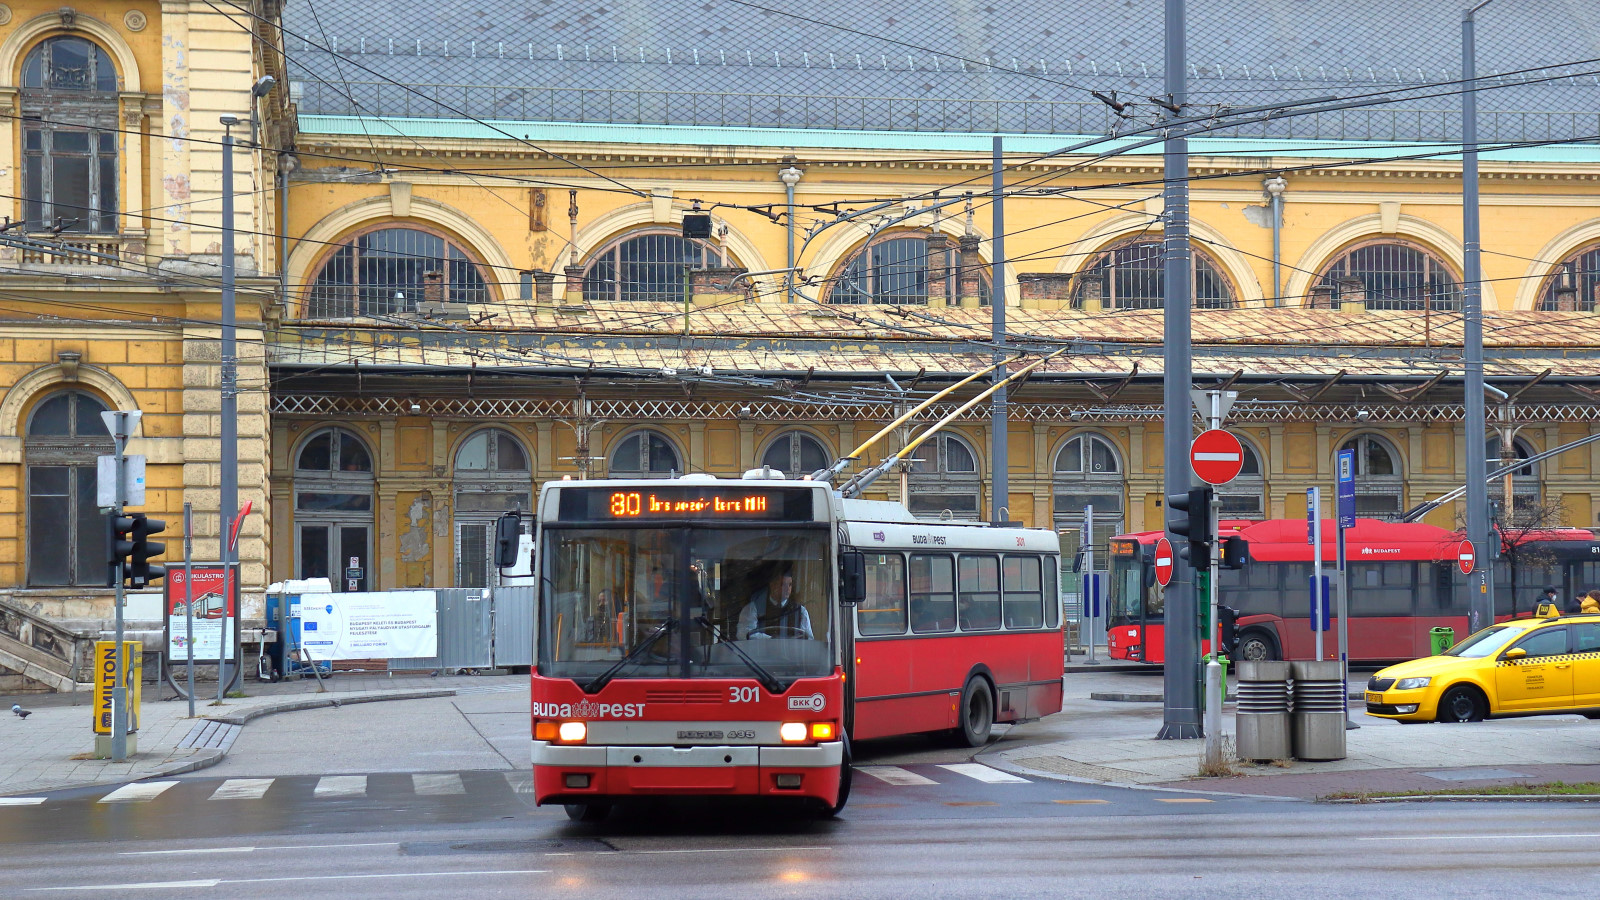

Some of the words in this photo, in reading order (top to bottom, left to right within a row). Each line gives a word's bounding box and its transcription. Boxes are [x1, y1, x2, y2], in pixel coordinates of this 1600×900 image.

[611, 493, 640, 515] 80
[714, 496, 741, 511] tere
[729, 686, 760, 703] 301
[677, 730, 724, 739] IKARUS
